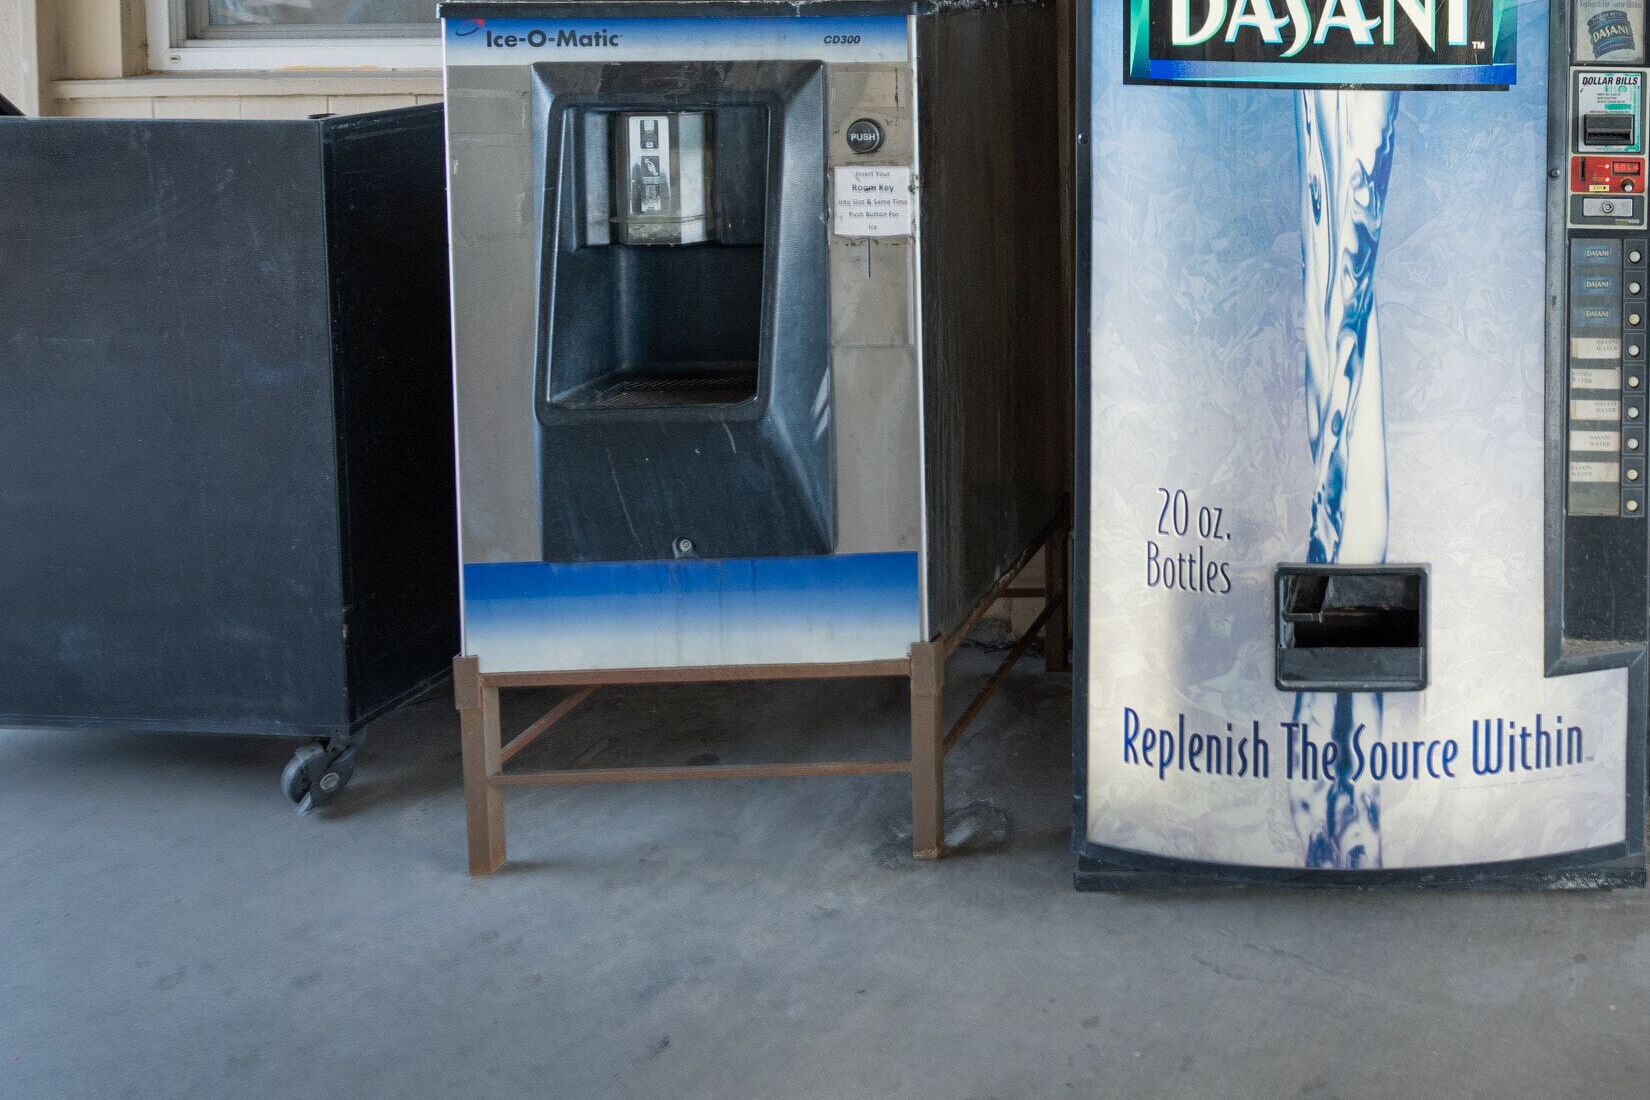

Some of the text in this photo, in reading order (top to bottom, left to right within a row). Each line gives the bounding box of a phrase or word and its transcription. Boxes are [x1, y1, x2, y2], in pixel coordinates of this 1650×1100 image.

[486, 28, 619, 48] Ice-O-Matic
[824, 34, 861, 46] CD300
[1593, 25, 1629, 43] DASANI
[1582, 76, 1638, 85] DOLLAR BILLS
[850, 133, 875, 141] PUSH
[879, 184, 894, 193] Key
[1157, 487, 1232, 540] 20 oz.
[1146, 540, 1232, 594] Bottles
[1123, 707, 1269, 781] Replenish
[1281, 721, 1338, 782] The
[1350, 722, 1459, 783] Source
[1472, 715, 1583, 778] Within
